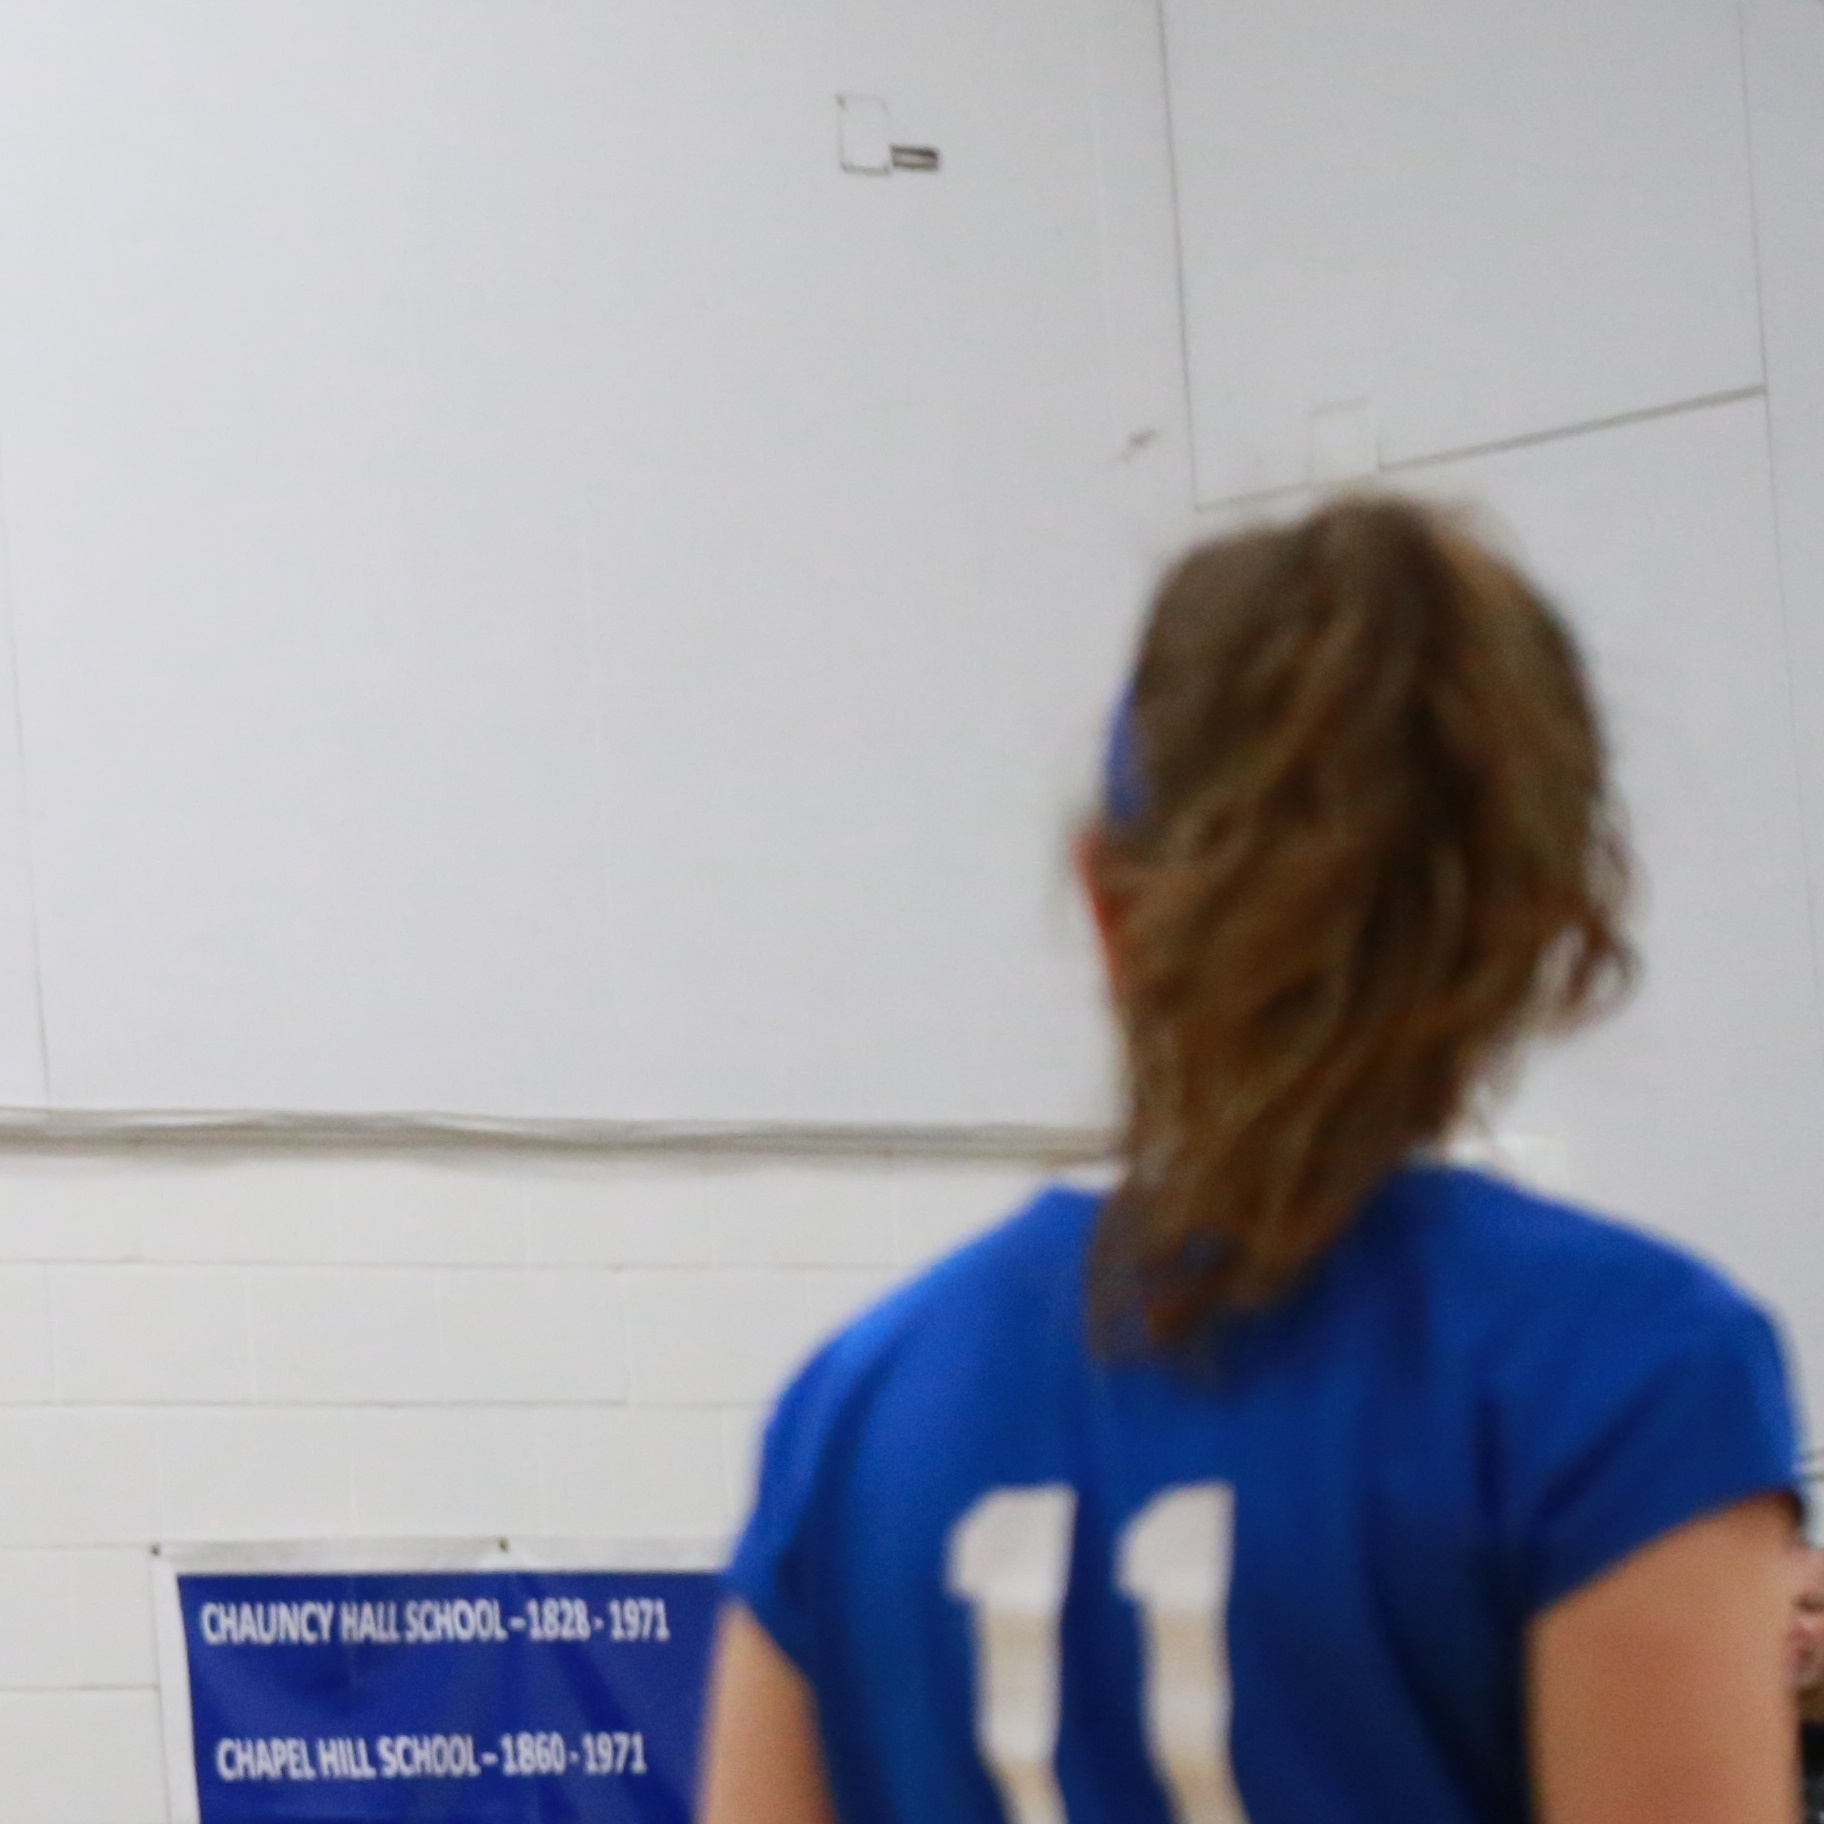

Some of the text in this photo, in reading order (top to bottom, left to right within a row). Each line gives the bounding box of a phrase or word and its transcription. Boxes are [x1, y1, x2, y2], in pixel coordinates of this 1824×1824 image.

[201, 1601, 334, 1646] CHAUNCY
[341, 1600, 400, 1643] HALL
[405, 1599, 507, 1642] SCHOOL
[526, 1598, 591, 1642] 1828
[609, 1598, 670, 1642] 1971
[216, 1737, 316, 1781] CHAPEL
[317, 1737, 376, 1779] HILL
[378, 1735, 480, 1778] SCHOOL
[499, 1733, 565, 1776] 1860
[583, 1732, 647, 1775] 1971
